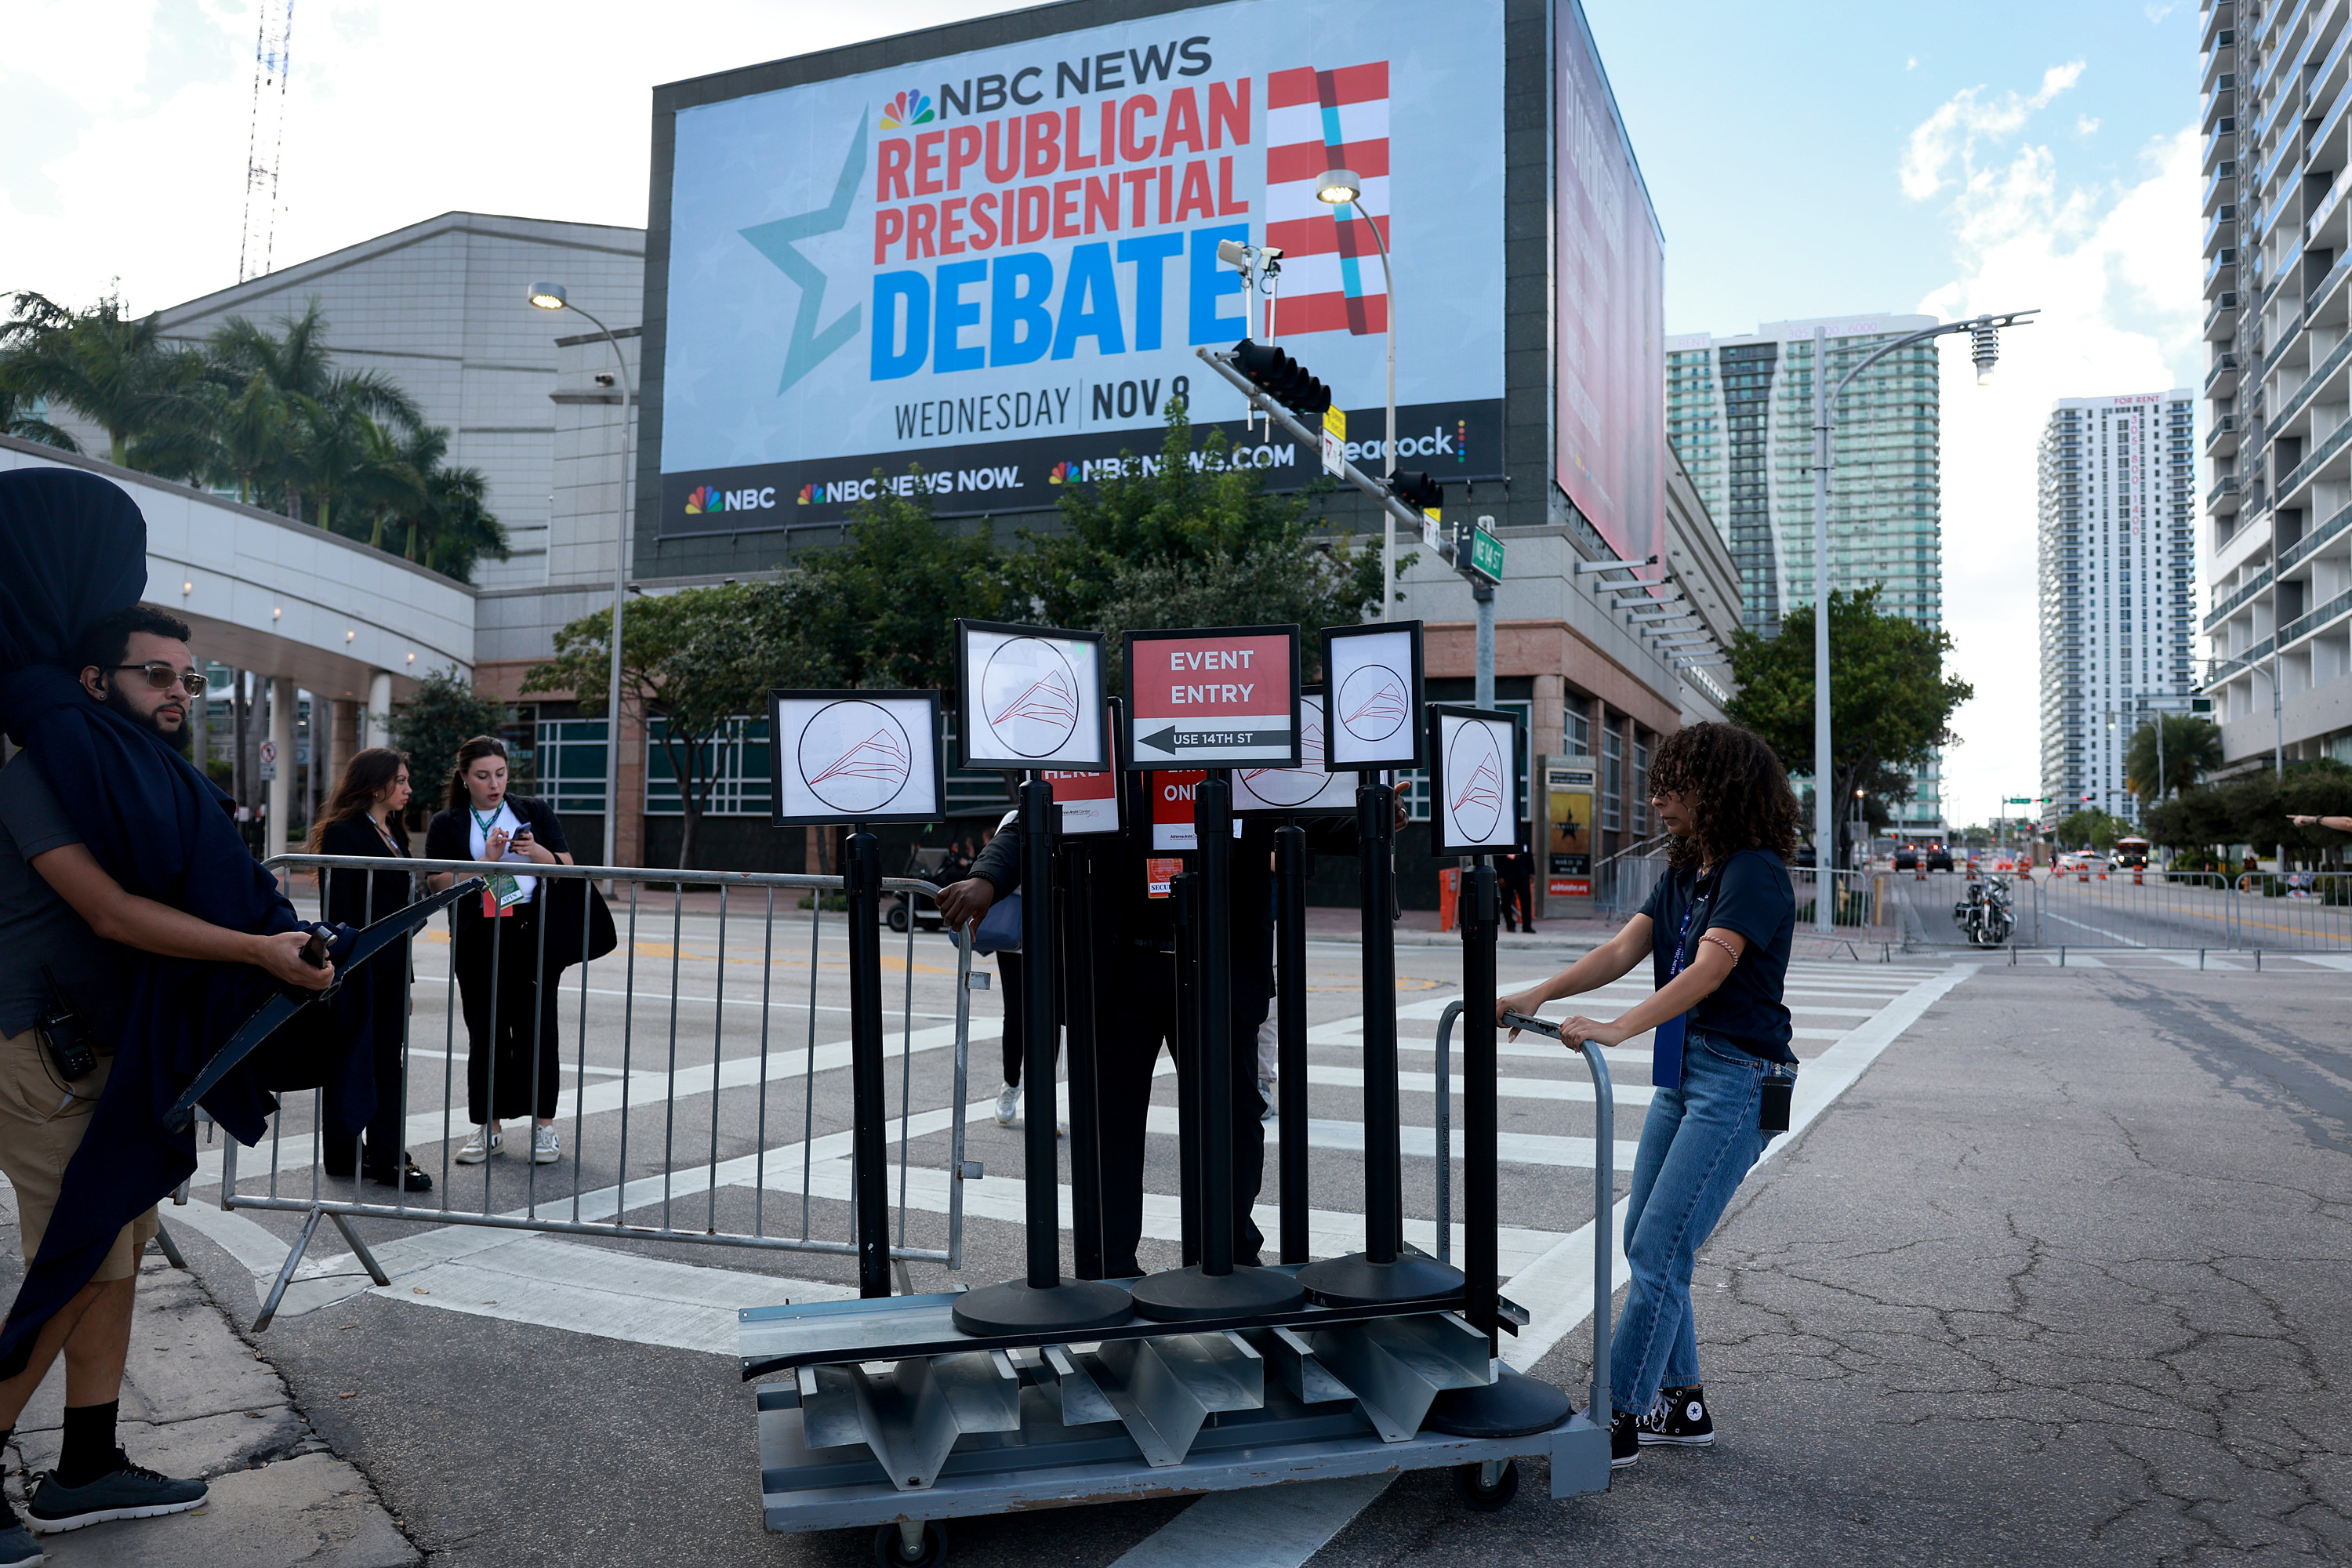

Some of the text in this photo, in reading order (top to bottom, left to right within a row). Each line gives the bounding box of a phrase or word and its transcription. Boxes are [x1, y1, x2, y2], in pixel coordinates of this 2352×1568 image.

[940, 36, 1212, 120] NBC NEWS
[877, 77, 1251, 203] REPUBLICAN
[874, 156, 1249, 265] PRESIDENTIAL
[870, 223, 1250, 382] DEBATE
[1678, 337, 1707, 349] RENT
[895, 376, 1189, 440] WEDNESDAY NOV 8
[2114, 395, 2160, 405] FOR RENT
[1082, 443, 1295, 483] NBCNWS.COM
[1323, 426, 1454, 475] eacock
[724, 486, 776, 512] NBC
[826, 477, 877, 503] NBC
[880, 471, 953, 499] NEWS
[1475, 539, 1485, 561] NE
[1493, 550, 1501, 571] ST
[1171, 650, 1254, 671] EVENT
[1171, 683, 1254, 704] ENTRY
[1173, 731, 1253, 746] USE 14TH ST
[502, 893, 517, 902] SPIN
